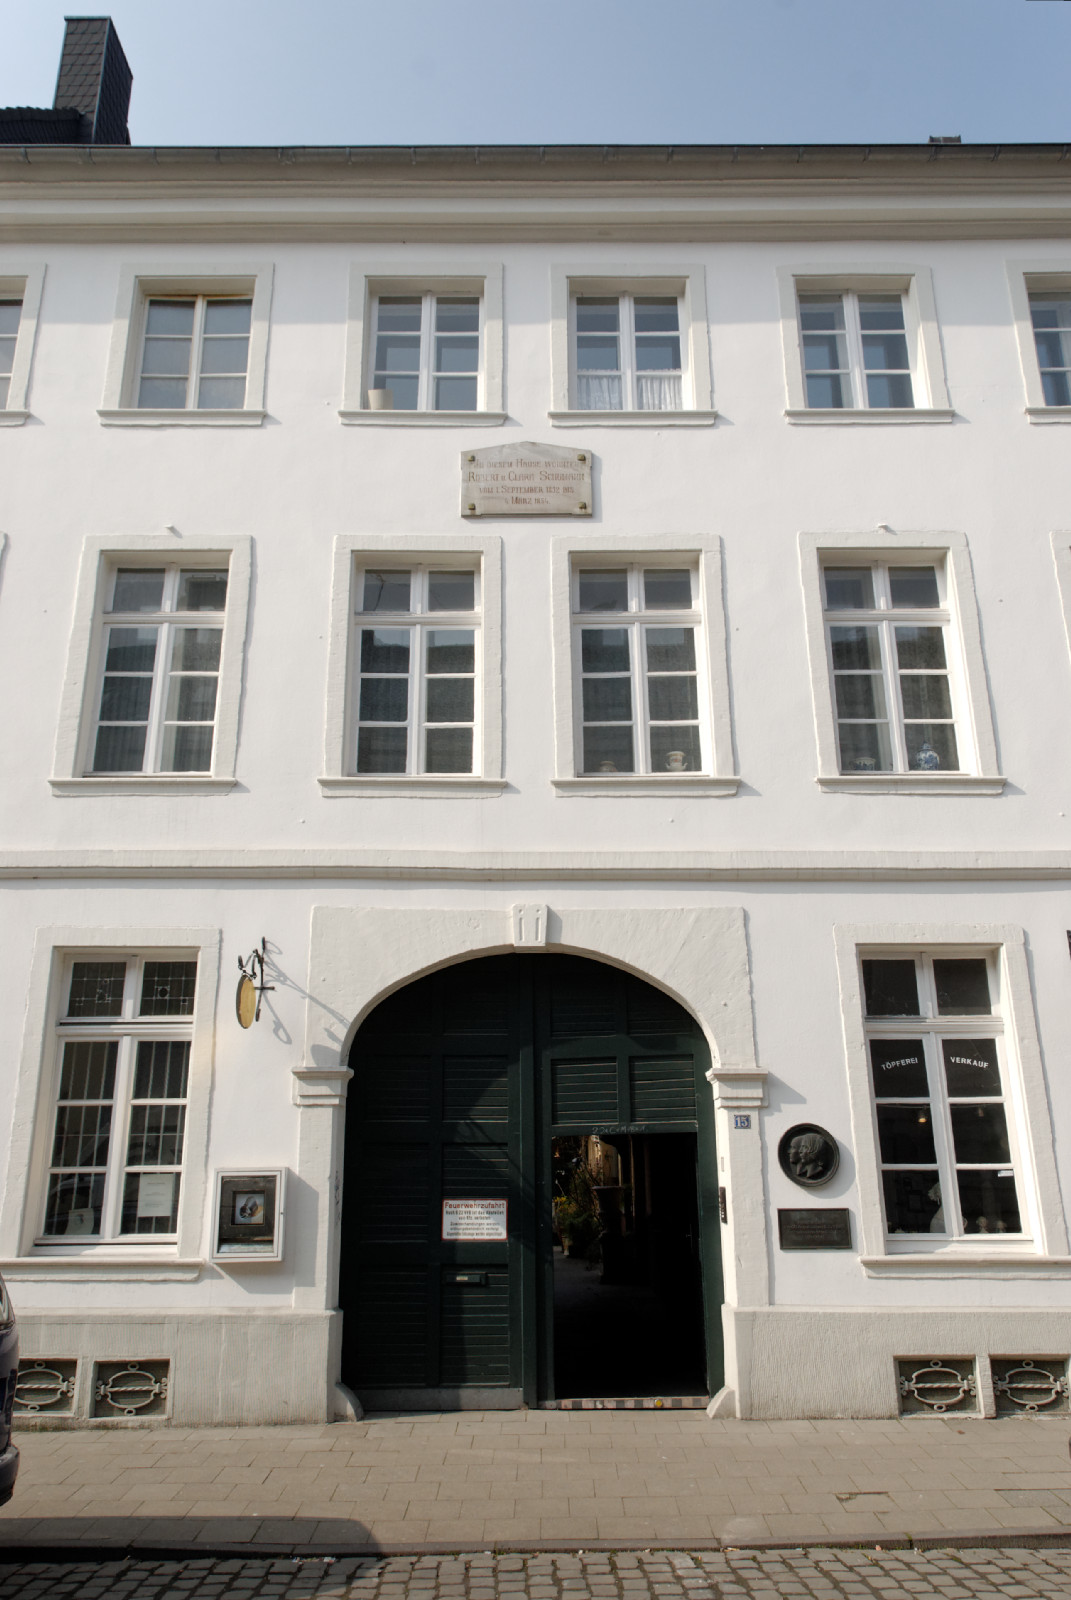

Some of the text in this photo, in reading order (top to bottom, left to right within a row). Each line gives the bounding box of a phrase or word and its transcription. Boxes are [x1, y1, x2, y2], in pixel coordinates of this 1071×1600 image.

[881, 1056, 989, 1071] TÖPFEREI VERKAUF
[737, 1116, 748, 1127] 15
